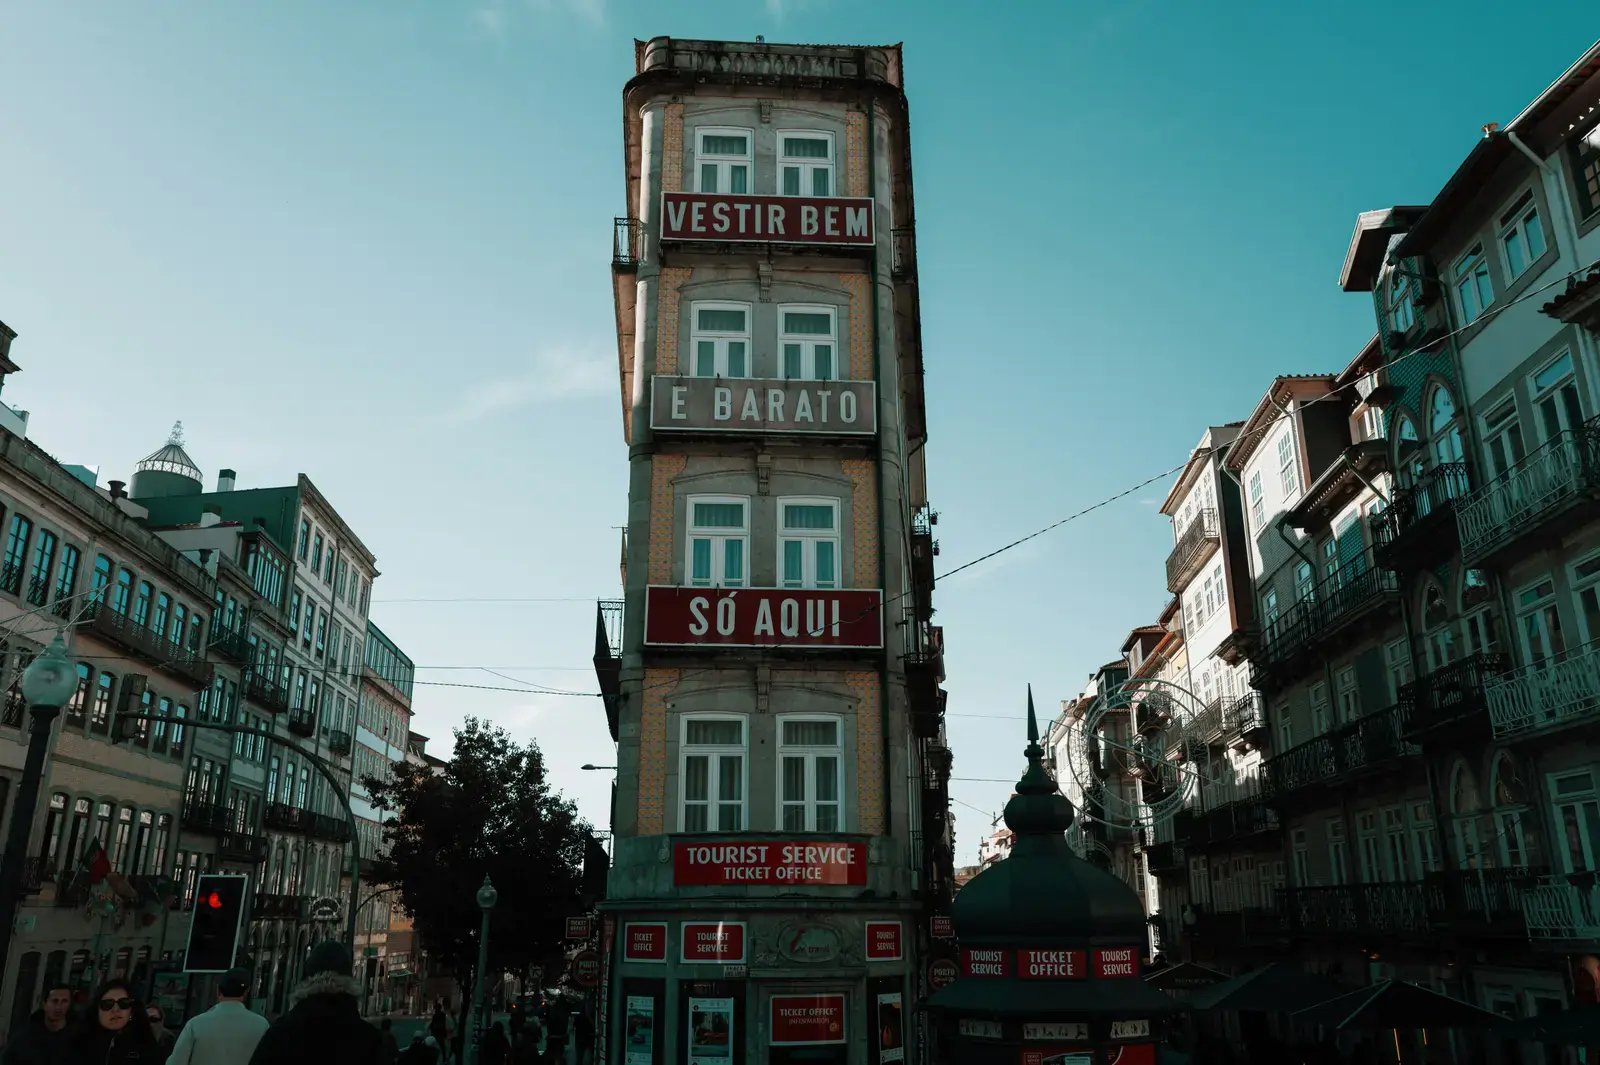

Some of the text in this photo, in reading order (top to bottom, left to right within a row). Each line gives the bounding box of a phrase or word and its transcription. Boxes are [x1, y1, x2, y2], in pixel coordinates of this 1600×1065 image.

[667, 201, 868, 237] VESTIR BEM
[671, 386, 857, 424] E BARATO
[688, 591, 840, 638] SÓ AQUI
[687, 845, 856, 865] TOURIST SERVICE
[723, 866, 822, 880] TICKET OFFICE
[633, 932, 653, 942] TICKET
[696, 932, 729, 941] TOURIST
[876, 931, 896, 940] TOURIST
[633, 942, 653, 952] OFFICE
[696, 943, 729, 953] SERVICE
[876, 941, 896, 951] SERVICE
[969, 949, 1003, 962] TOURIST
[1028, 951, 1073, 963] TICKET
[1101, 950, 1131, 962] TOURIST
[933, 967, 955, 976] PORTO
[970, 963, 1003, 976] SERVICE
[1029, 963, 1074, 976] OFFICE
[1103, 963, 1132, 976] SERVICE
[780, 1007, 834, 1017] TICKET OFFICE
[788, 1016, 830, 1025] INFORMATION
